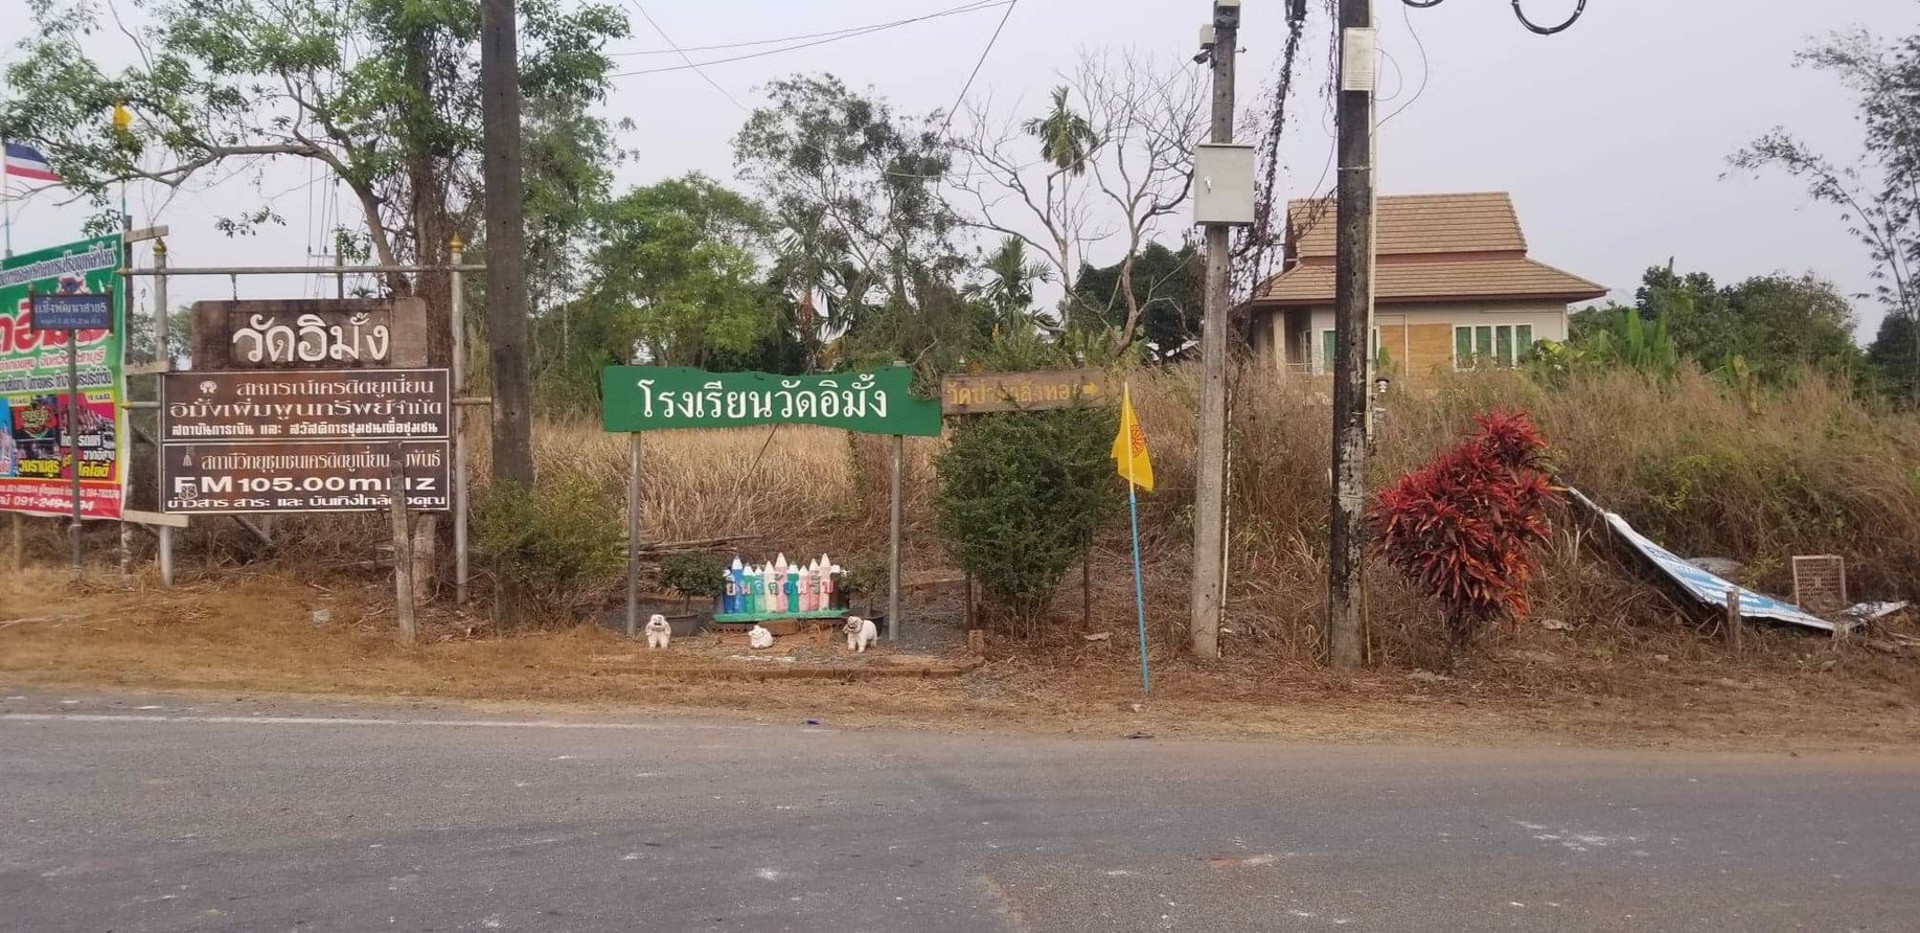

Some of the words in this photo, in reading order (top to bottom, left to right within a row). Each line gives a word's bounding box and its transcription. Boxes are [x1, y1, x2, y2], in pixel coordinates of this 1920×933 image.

[233, 312, 390, 363] วัดอิมั้ง
[236, 374, 434, 398] สหกรณ์เครดิตยูเนี่ยน
[637, 374, 888, 420] โรงเรียนวัดอิมั้ง
[172, 421, 254, 435] สถาบันการเงิน
[261, 422, 282, 435] และ
[290, 417, 438, 438] สวัสดิการชุมชนเพื่อชุมชน
[201, 445, 442, 473] สถานีวิทยุชุมชนเครดิตยูเนี่ยนพันธ์
[237, 476, 345, 492] 105.00
[167, 496, 229, 509] ข่าวสาร
[234, 497, 270, 508] สาระ
[278, 497, 303, 508] และ
